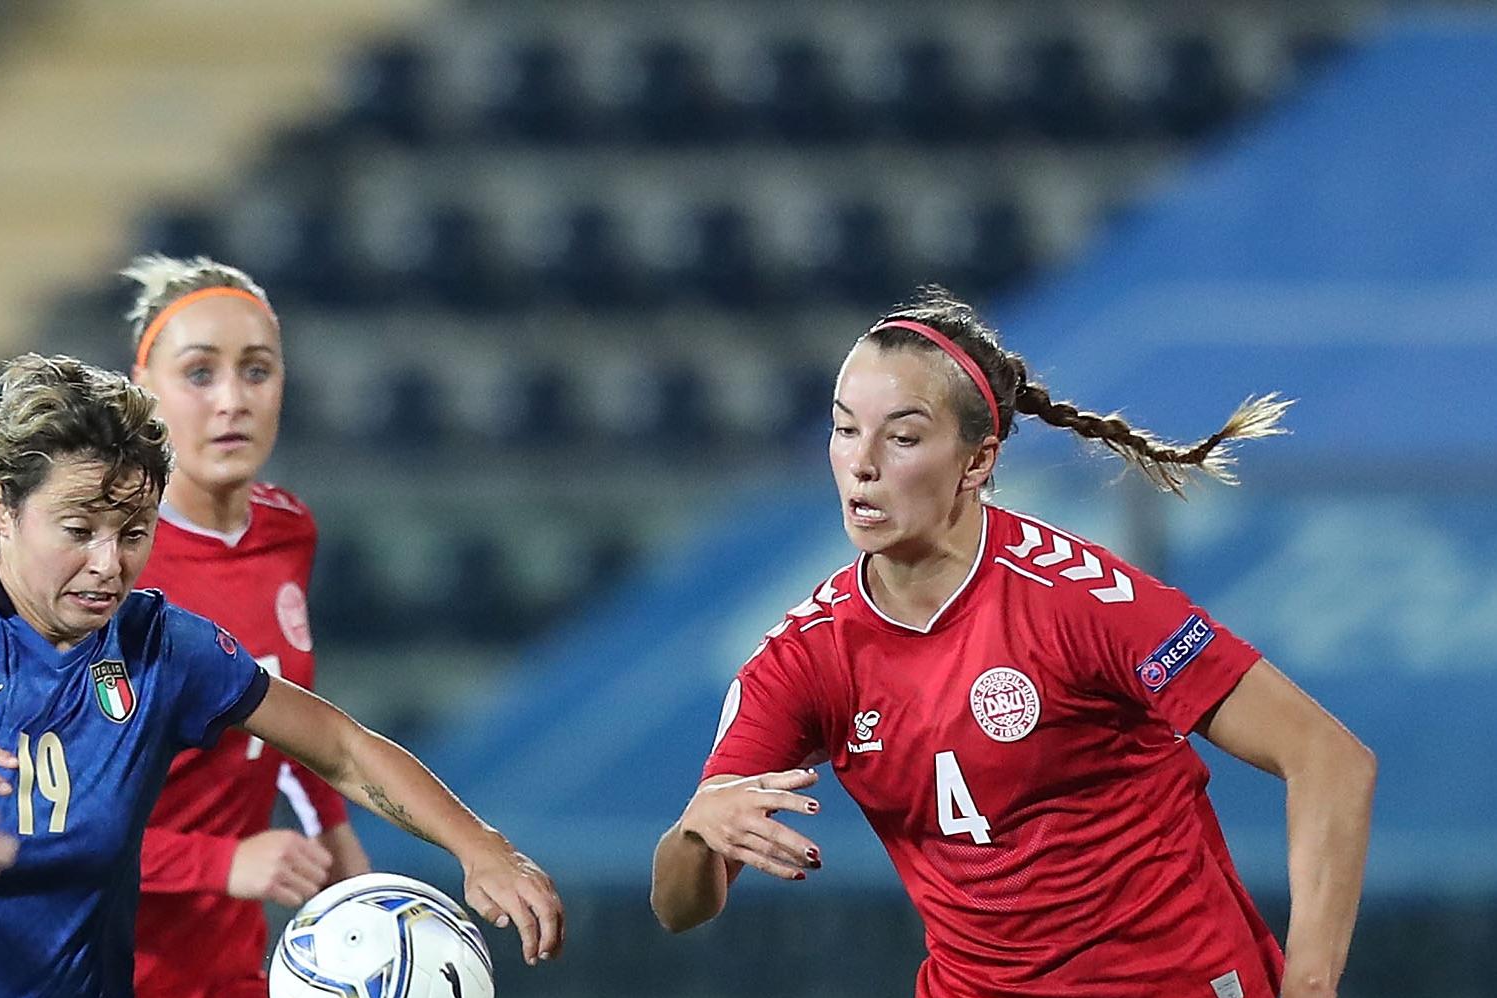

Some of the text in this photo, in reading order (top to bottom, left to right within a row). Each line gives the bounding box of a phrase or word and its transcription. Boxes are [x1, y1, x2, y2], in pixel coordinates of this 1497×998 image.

[1160, 618, 1209, 669] RESPECT
[93, 664, 122, 678] ITALIA
[984, 690, 1024, 717] DBU
[17, 731, 71, 835] 19
[935, 750, 992, 845] 4
